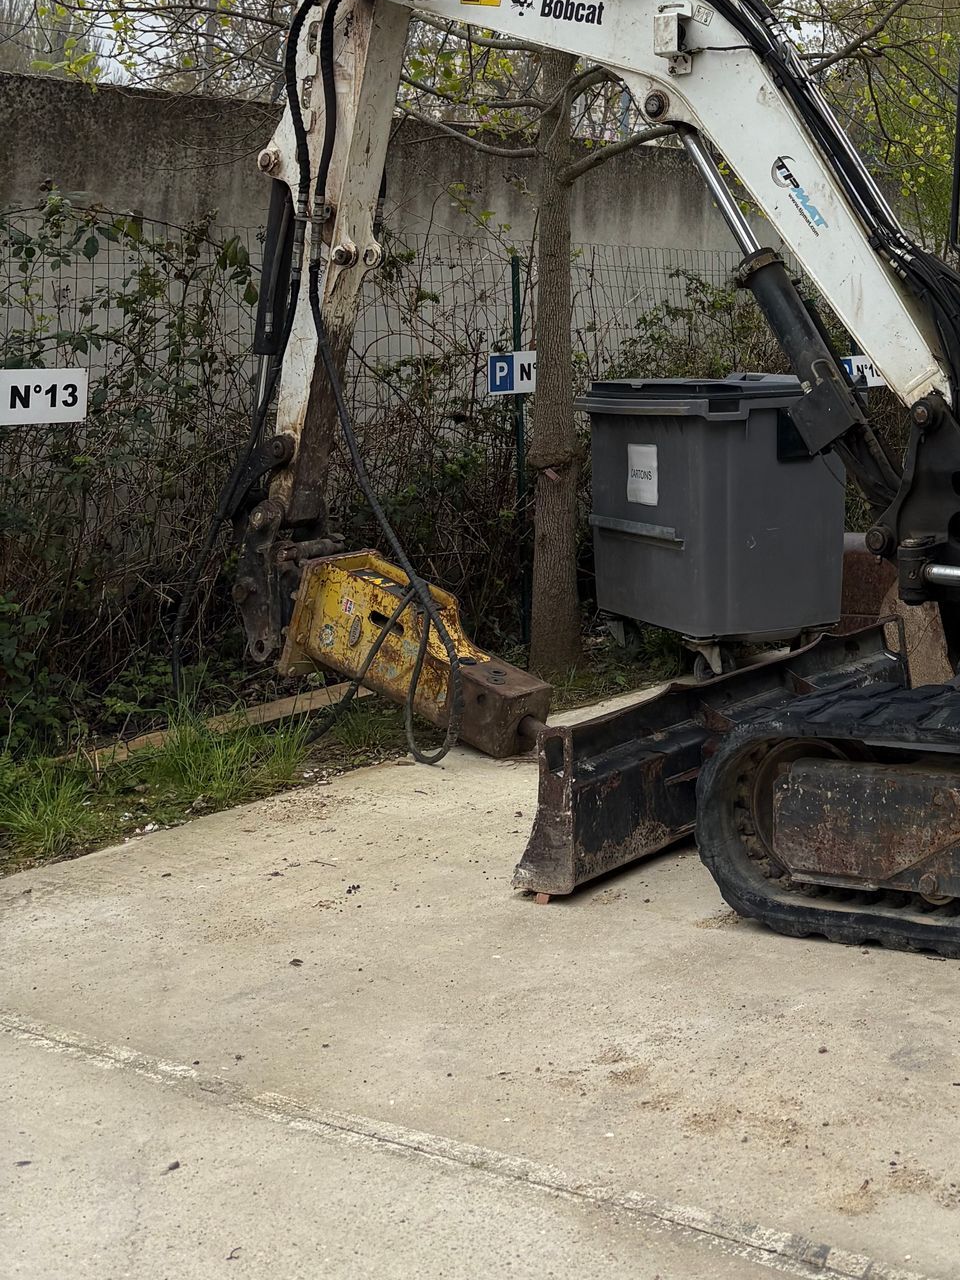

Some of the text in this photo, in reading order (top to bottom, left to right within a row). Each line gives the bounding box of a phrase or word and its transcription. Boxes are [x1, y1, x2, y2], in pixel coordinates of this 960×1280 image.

[788, 193, 820, 237] www.tipmat.com
[495, 361, 509, 385] P
[10, 383, 78, 409] N°13
